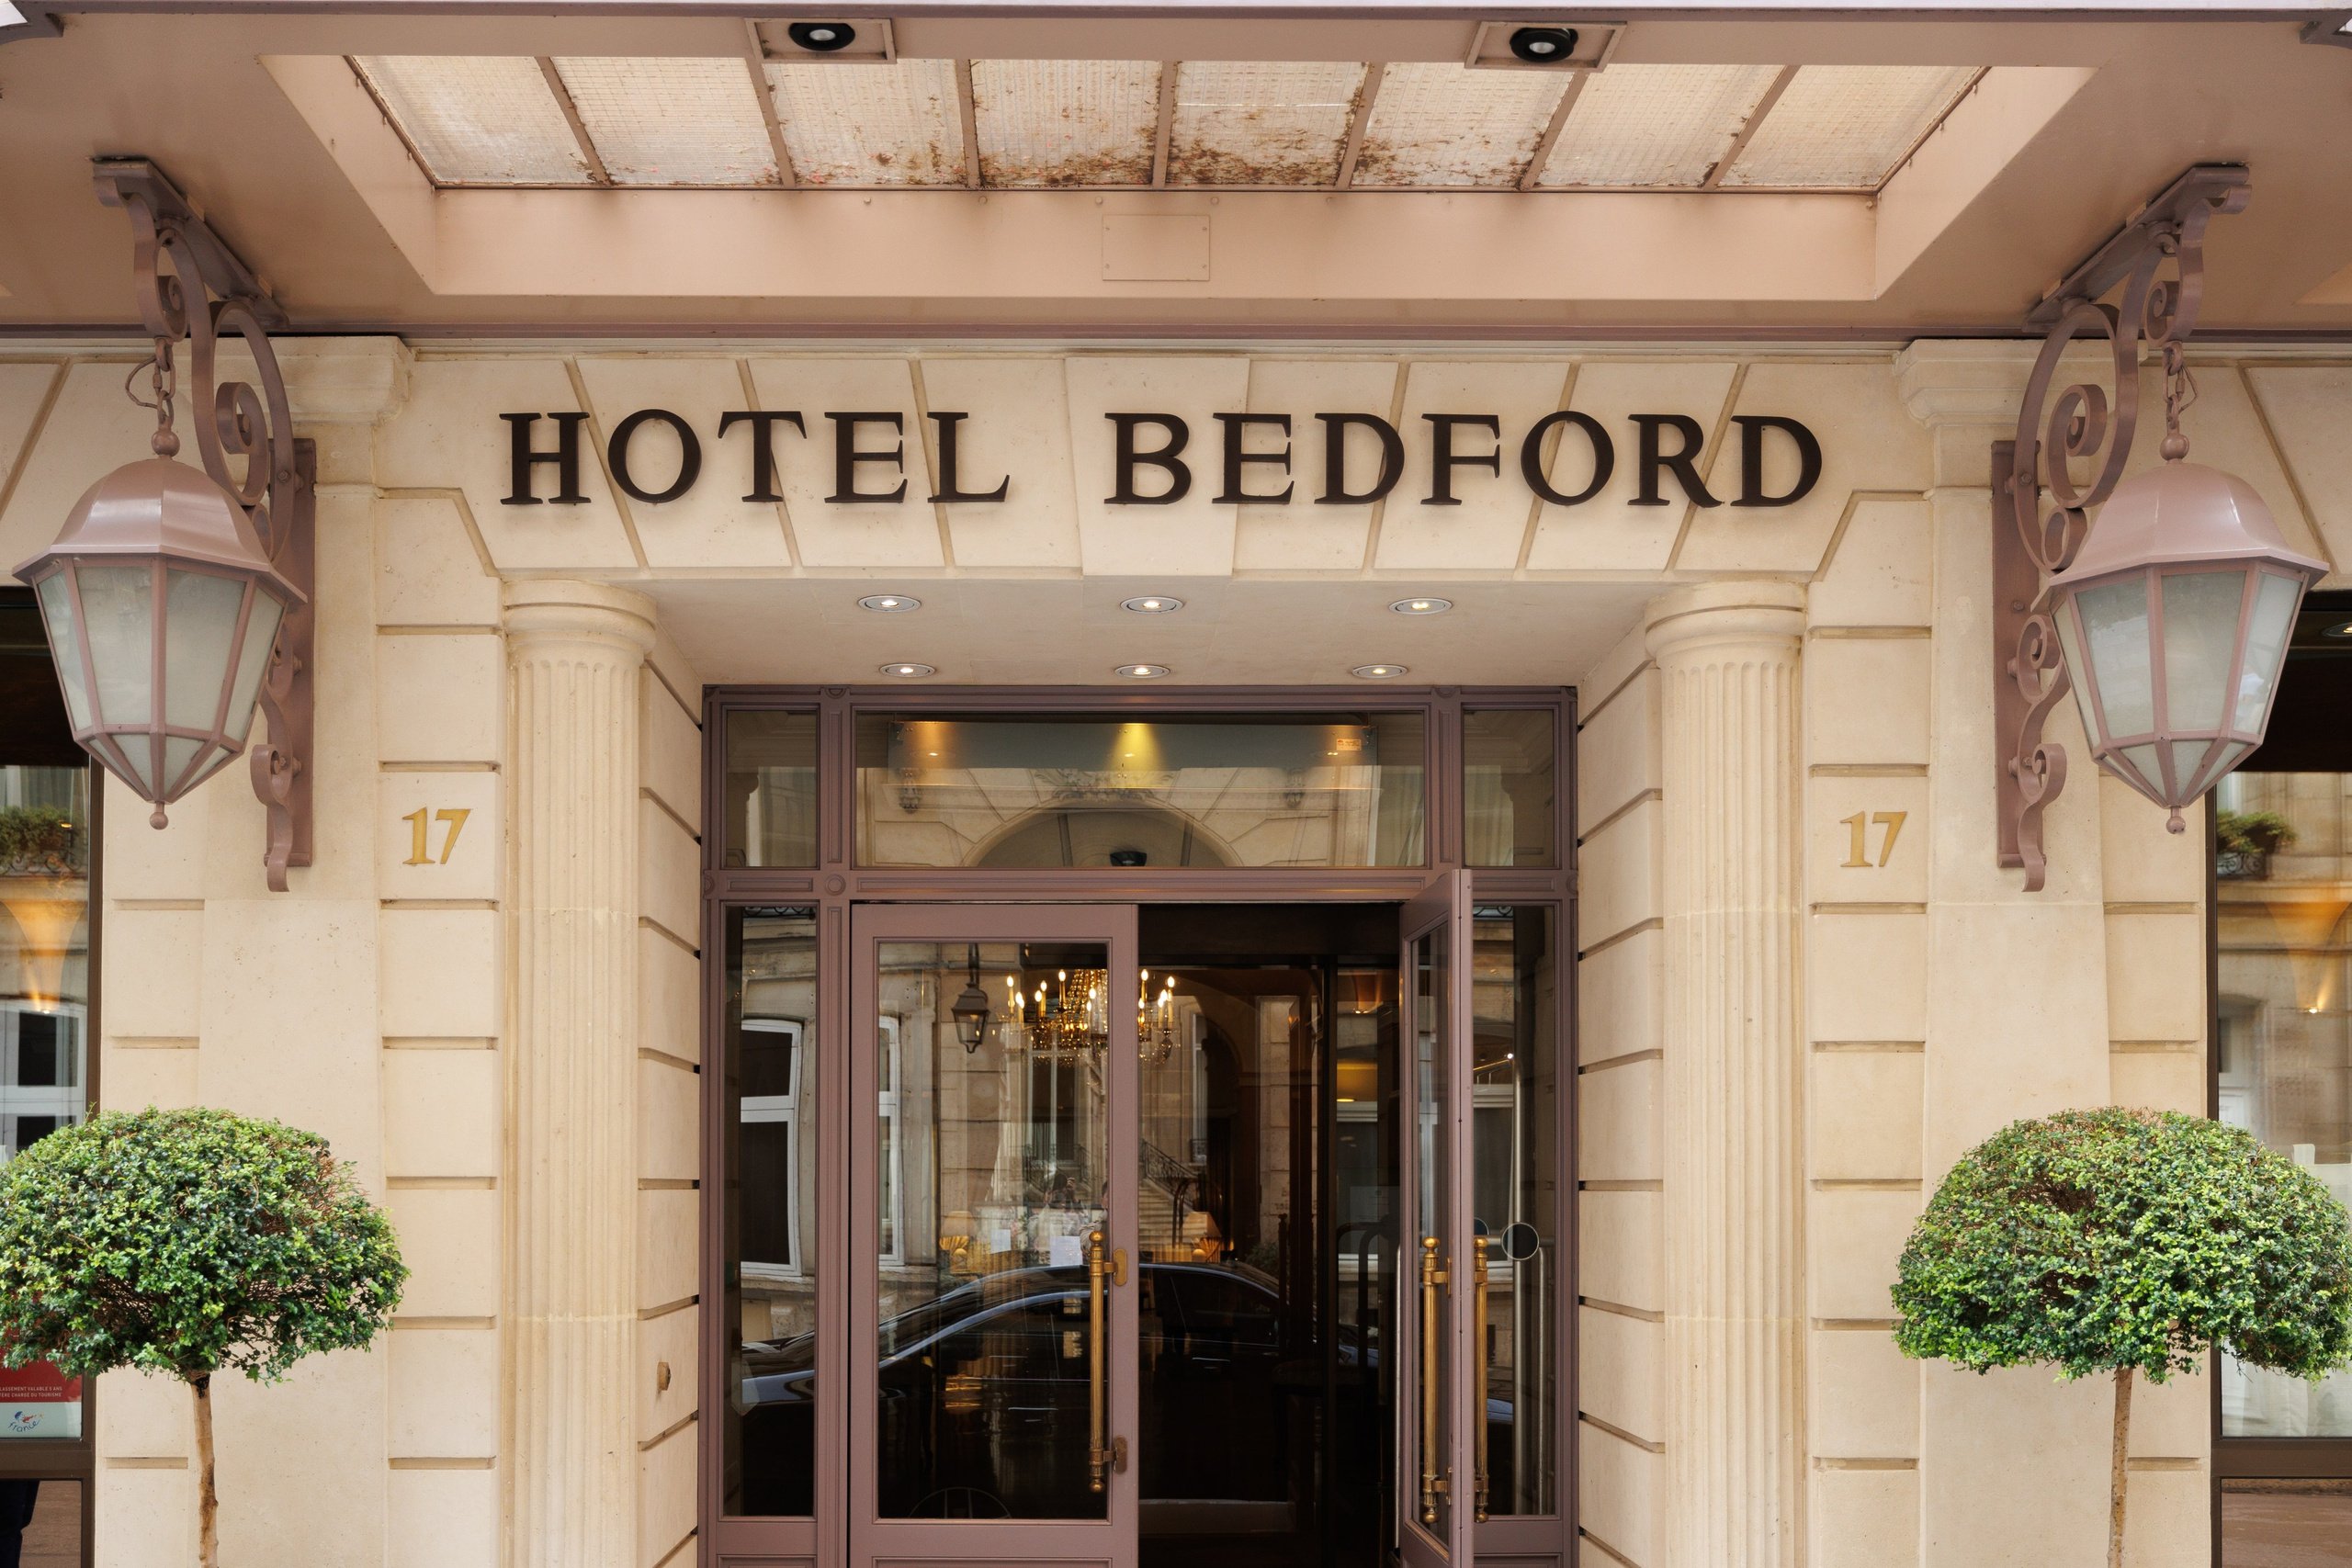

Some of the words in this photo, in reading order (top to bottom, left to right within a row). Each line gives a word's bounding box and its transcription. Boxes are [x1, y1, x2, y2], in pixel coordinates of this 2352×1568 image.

[500, 410, 1010, 505] HOTEL
[1104, 411, 1823, 507] BEDFORD
[402, 807, 471, 864] 17
[1839, 810, 1907, 867] 17
